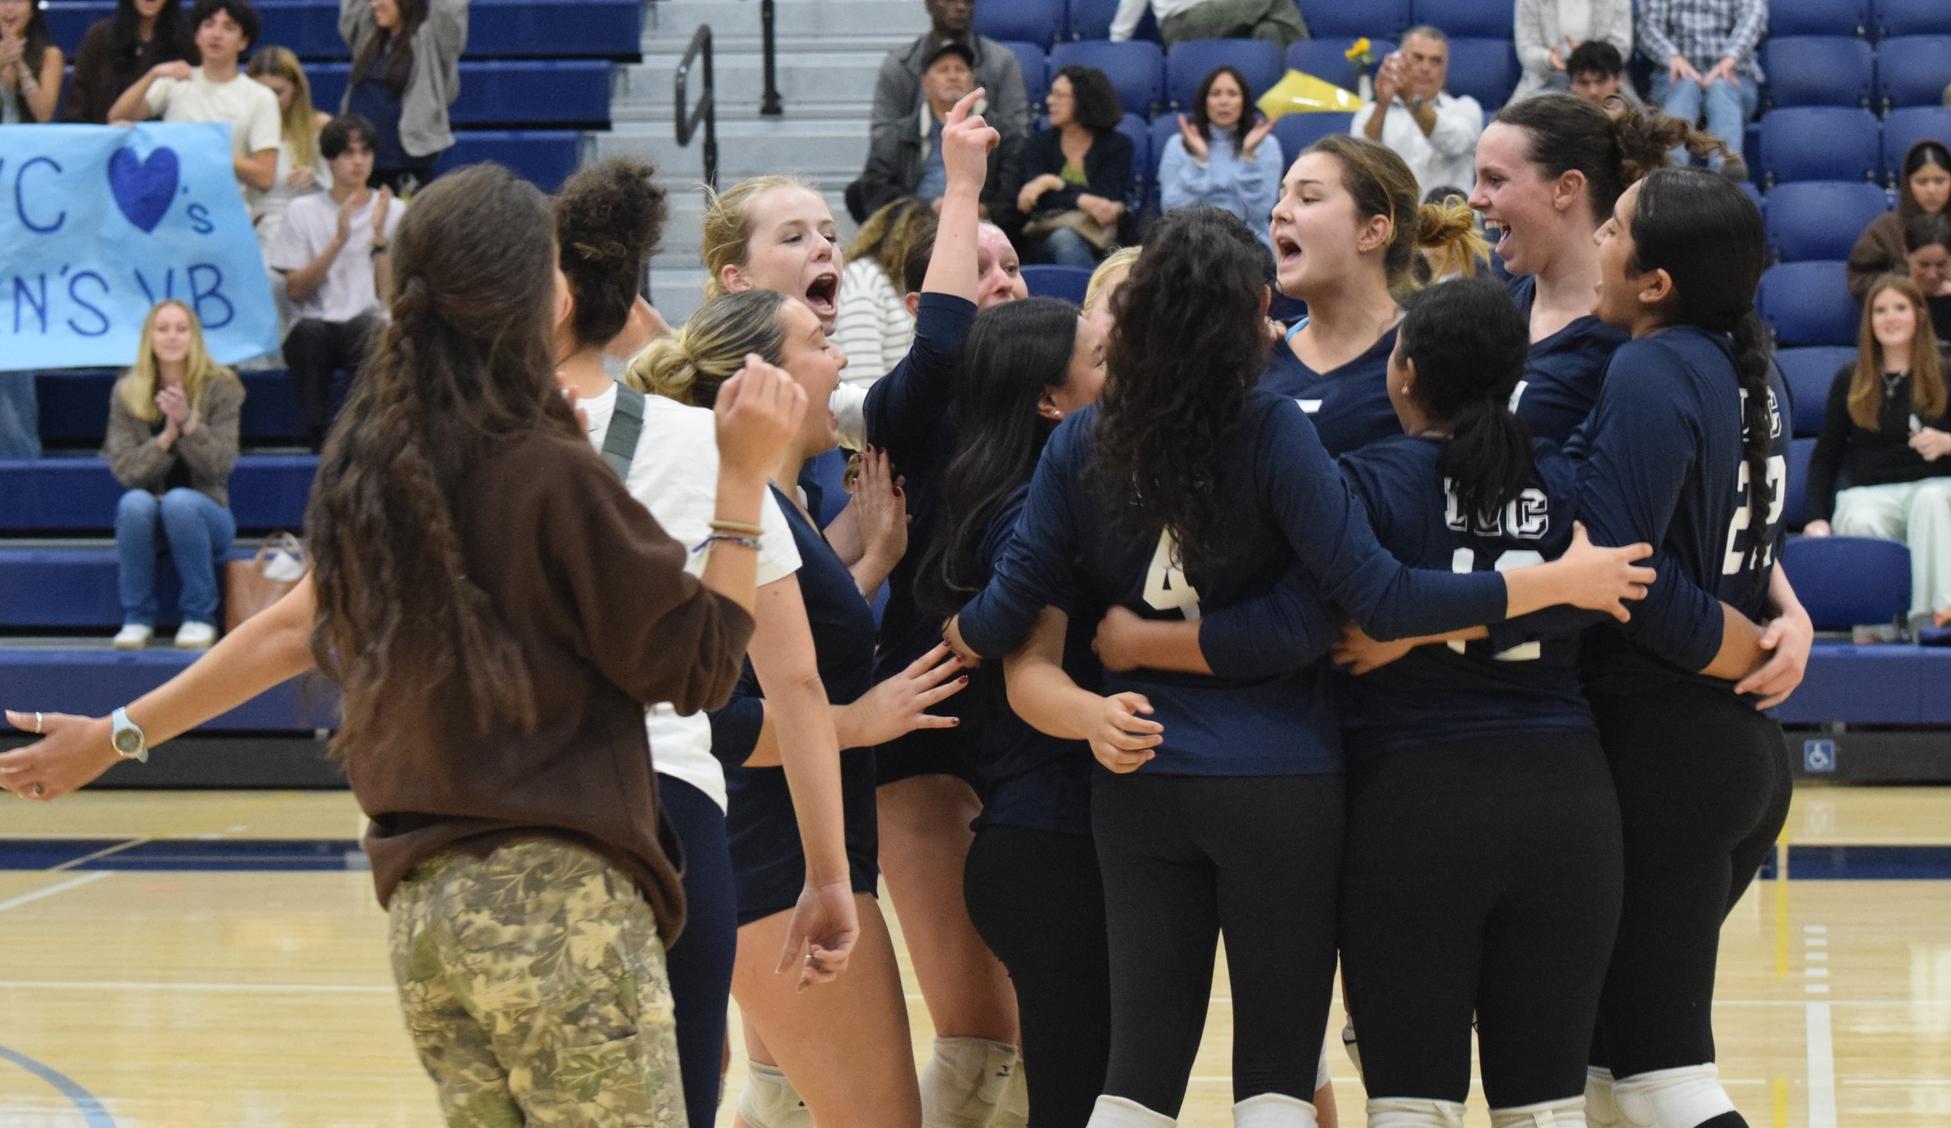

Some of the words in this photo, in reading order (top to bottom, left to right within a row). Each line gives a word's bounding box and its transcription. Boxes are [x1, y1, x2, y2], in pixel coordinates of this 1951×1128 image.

[0, 156, 66, 235] C
[0, 264, 110, 337] N'S
[1142, 525, 1200, 621] 4
